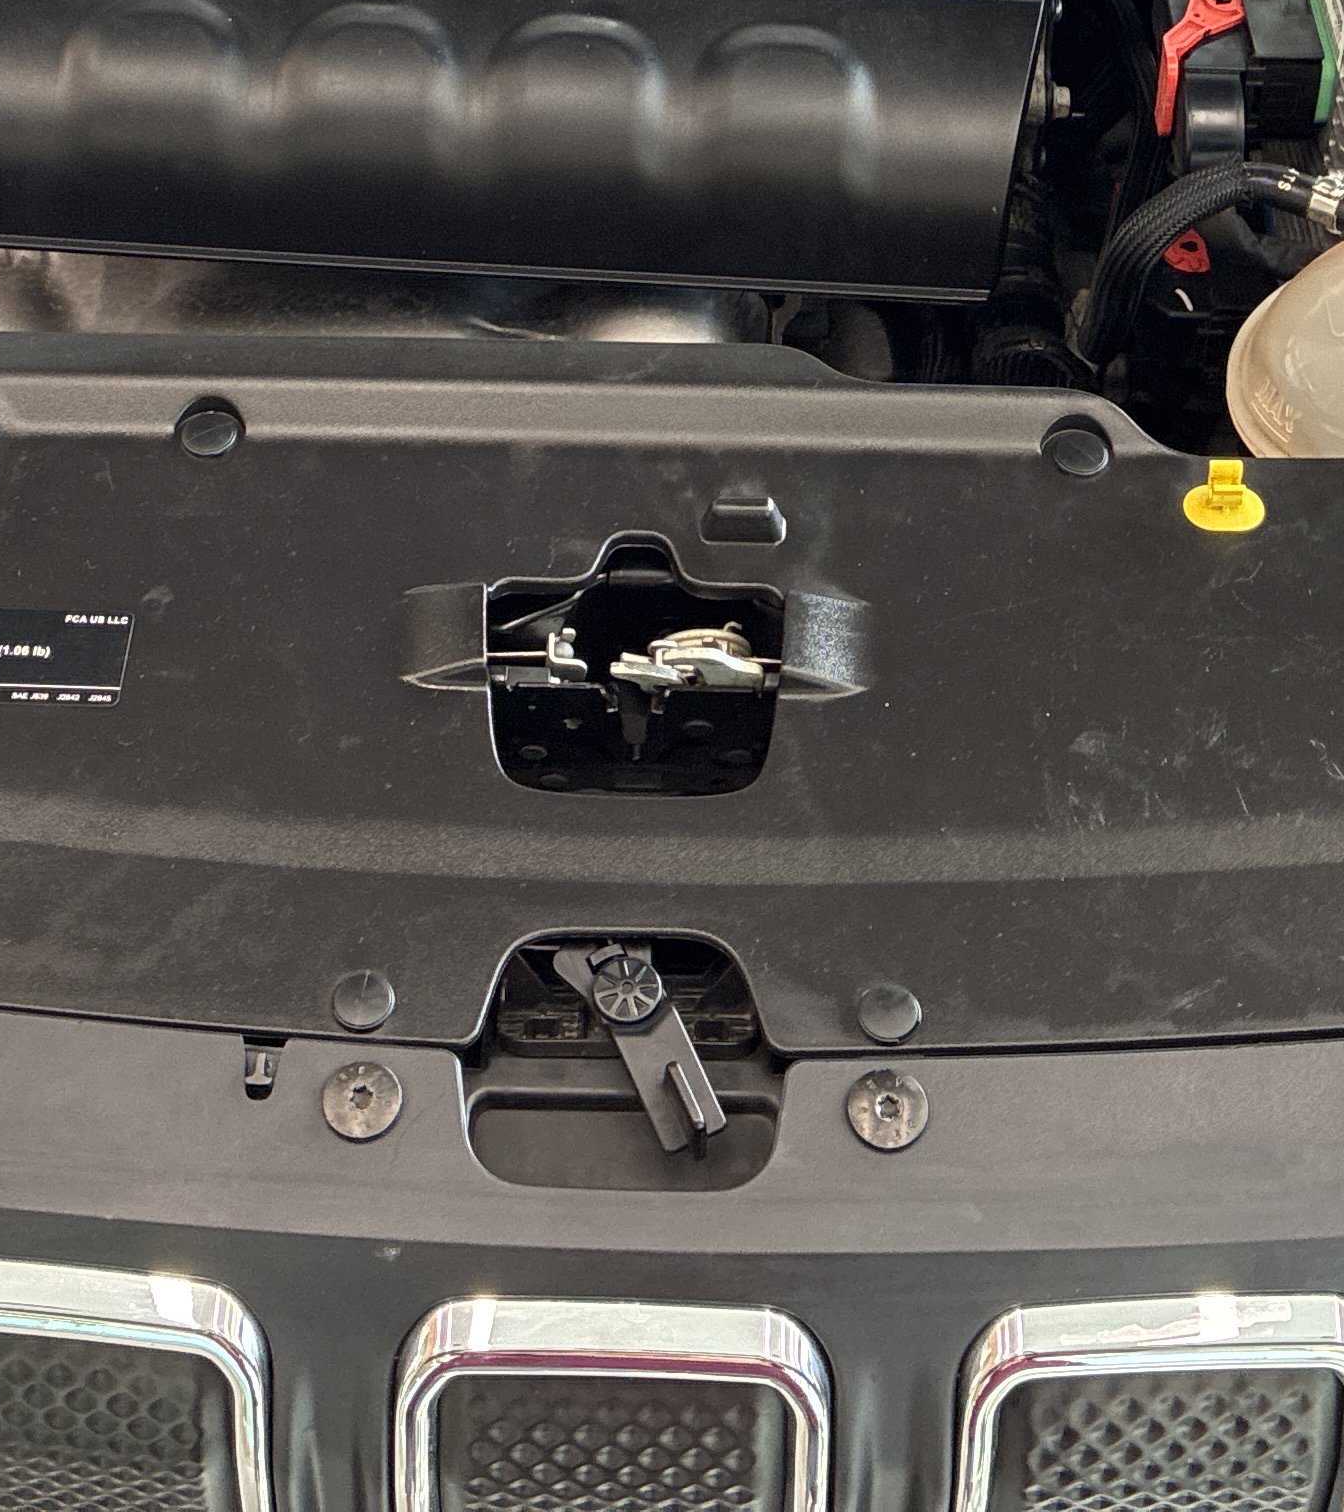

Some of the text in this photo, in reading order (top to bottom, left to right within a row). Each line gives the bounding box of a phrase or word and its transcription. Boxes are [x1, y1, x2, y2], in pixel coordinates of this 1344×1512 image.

[64, 614, 88, 624] FCA
[106, 615, 129, 625] LLC
[32, 645, 51, 659] lb)
